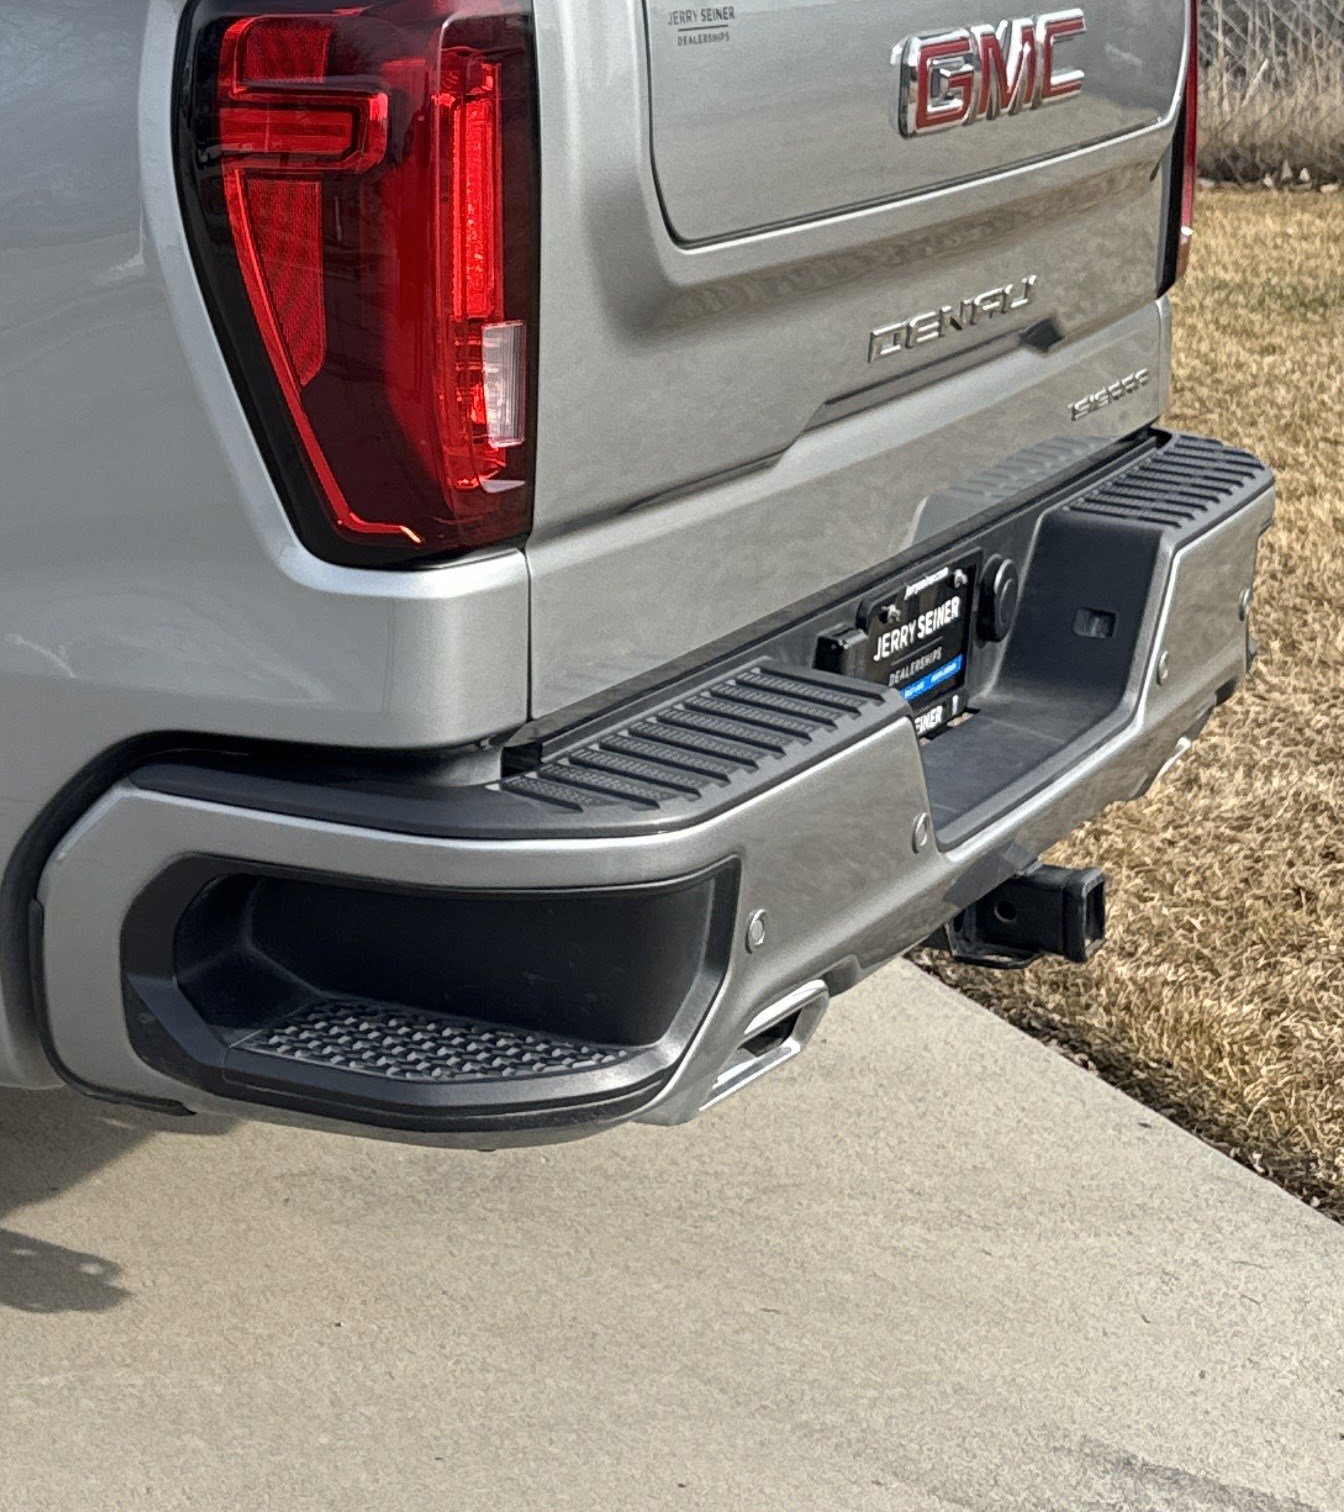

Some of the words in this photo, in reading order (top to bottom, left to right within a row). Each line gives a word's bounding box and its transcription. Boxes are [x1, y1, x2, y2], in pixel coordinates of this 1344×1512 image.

[668, 9, 698, 26] JERRY
[700, 5, 736, 23] SEINER
[895, 8, 1087, 138] GMC
[867, 274, 1038, 363] DENALI
[873, 619, 917, 662] JERRY
[917, 595, 961, 639] SEINER
[889, 646, 943, 687] DEALERSHIPS
